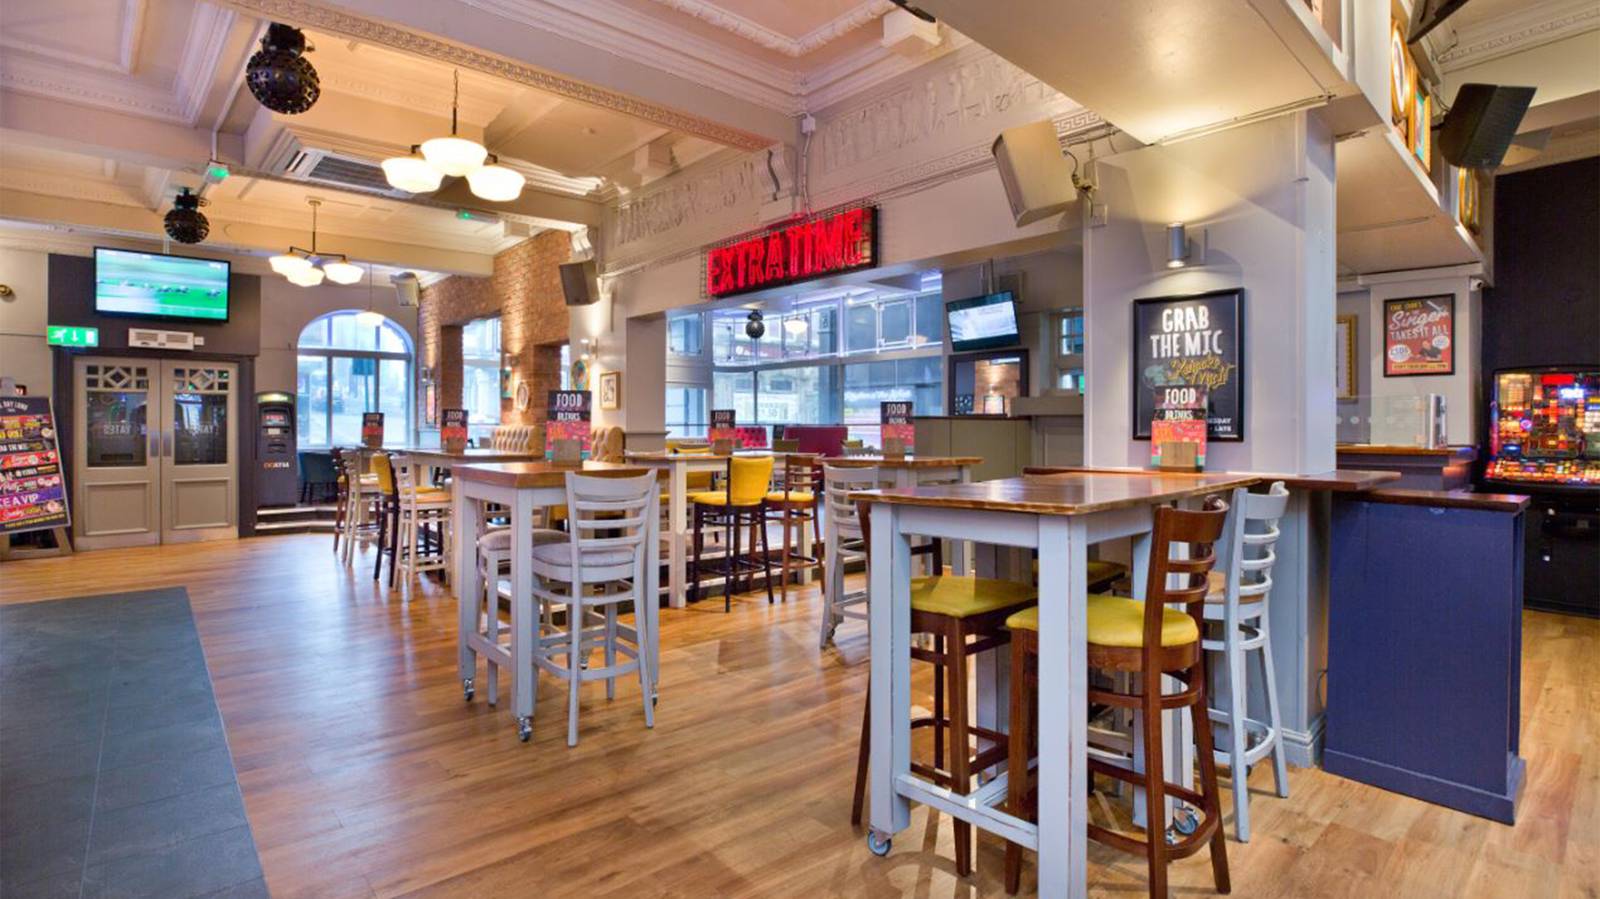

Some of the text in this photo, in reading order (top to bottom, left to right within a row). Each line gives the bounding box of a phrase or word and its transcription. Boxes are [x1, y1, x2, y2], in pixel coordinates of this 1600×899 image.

[706, 207, 864, 296] EXTRA TIME
[1162, 305, 1210, 333] GRAB
[1389, 310, 1450, 330] Singer
[1431, 323, 1449, 337] ALL
[1150, 329, 1223, 359] THE MIC
[556, 393, 583, 408] FOOD
[1164, 387, 1197, 405] FOOD
[886, 403, 907, 417] FOOD
[1164, 409, 1194, 421] DRINKS
[21, 493, 39, 505] VIP
